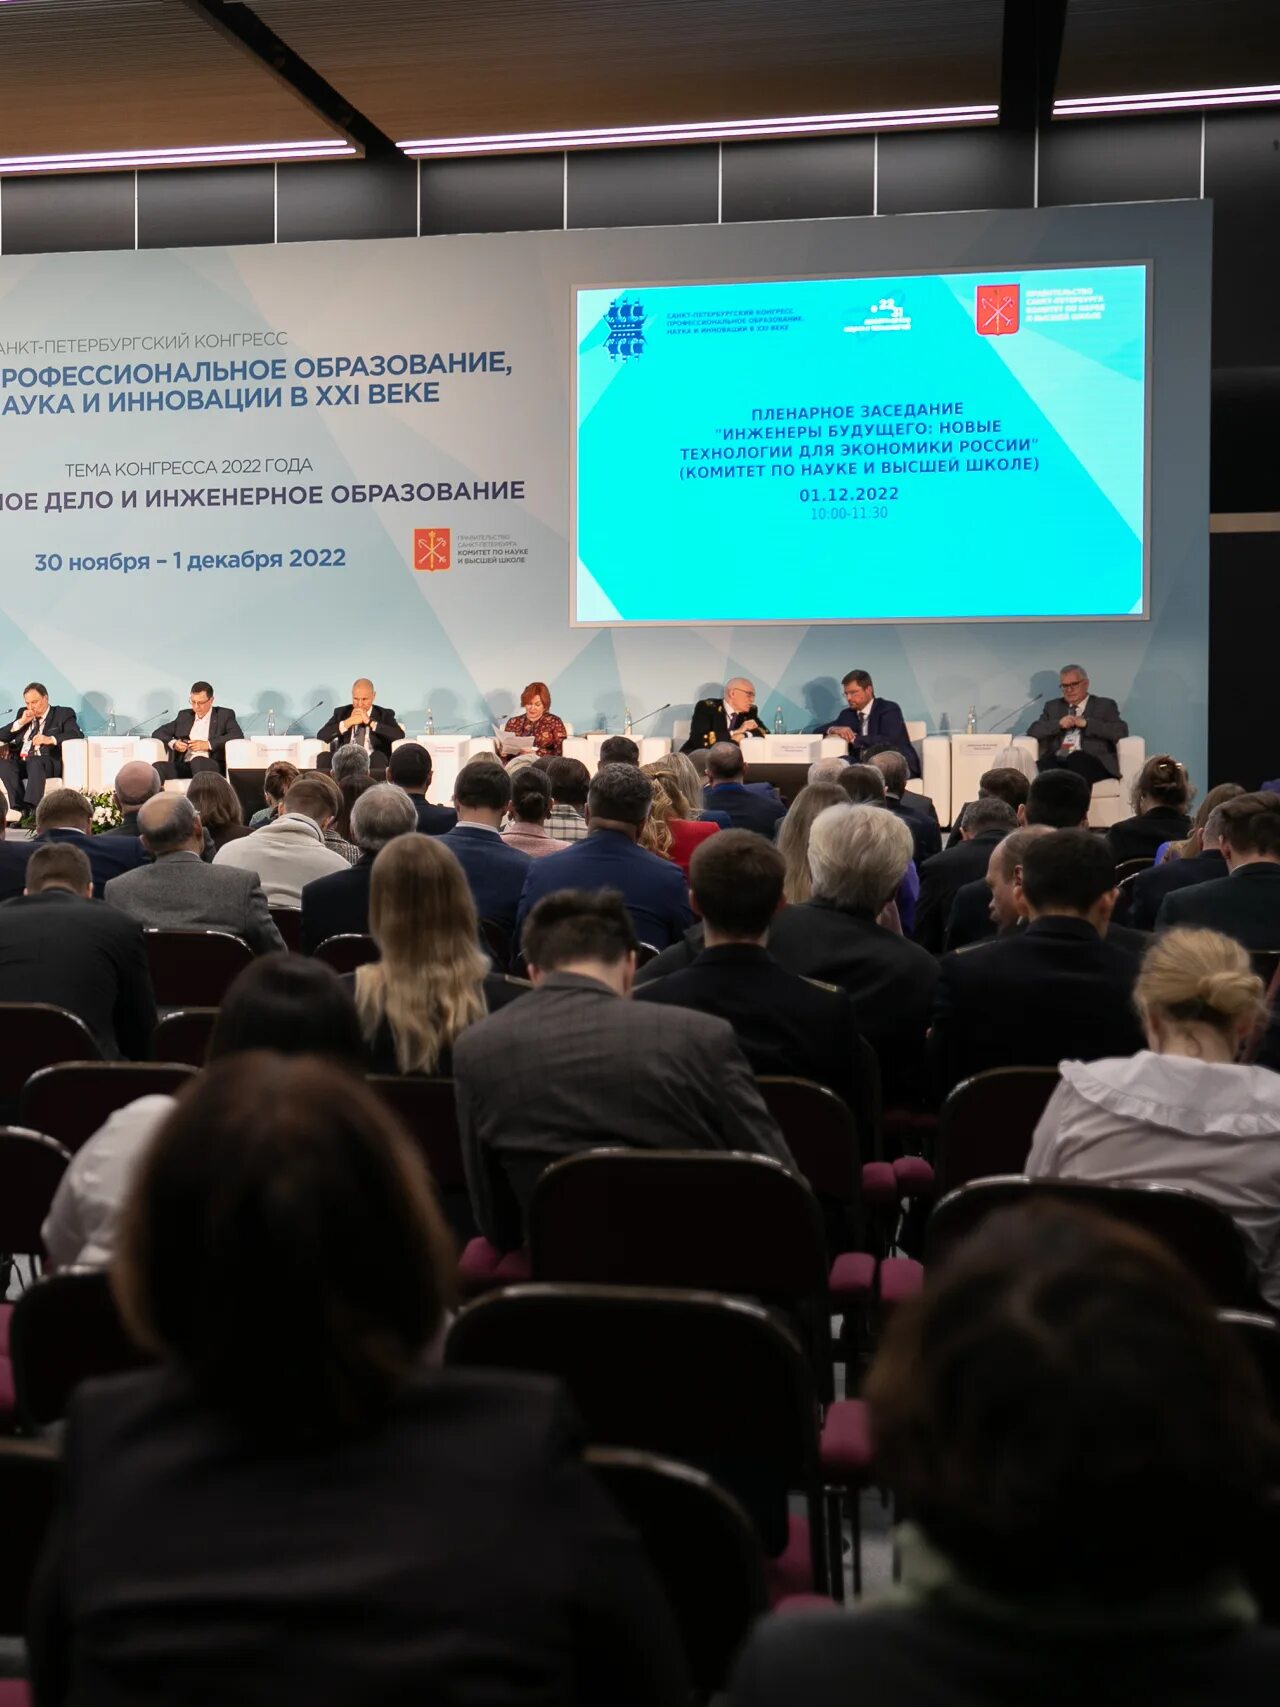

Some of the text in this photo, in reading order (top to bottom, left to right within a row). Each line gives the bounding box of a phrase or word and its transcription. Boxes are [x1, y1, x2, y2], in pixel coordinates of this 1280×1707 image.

[195, 332, 288, 349] КОНГРЕСС
[294, 351, 512, 379] ОБРАЗОВАНИЕ,
[83, 393, 100, 413] И
[109, 387, 282, 412] ИННОВАЦИИ
[290, 386, 308, 407] В
[369, 382, 440, 404] ВЕКЕ
[752, 402, 964, 421] ПЛЕНАРНОЕ ЗАСЕДАНИЕ
[716, 420, 1001, 440] "ИНЖЕНЕРЫ БУДУЩЕГО: НОВЫЕ
[680, 439, 1039, 461] ТЕХНОЛОГИИ ДЛЯ ЭКОНОМИКИ РОССИИ"
[65, 458, 313, 478] ТЕМА КОНГРЕССА 2022 ГОДА
[680, 456, 1039, 481] (КОМИТЕТ ПО НАУКЕ И ВЫСШЕЙ ШКОЛЕ)
[45, 491, 113, 513] ДЕЛО
[121, 490, 137, 508] И
[145, 486, 323, 507] ИНЖЕНЕРНОЕ
[331, 481, 525, 503] ОБРАЗОВАНИЕ
[800, 487, 898, 502] 01.12.2022
[35, 553, 63, 571] 30
[70, 552, 150, 573] ноября
[173, 552, 181, 569] 1
[187, 549, 282, 571] декабря
[289, 548, 346, 567] 2022
[464, 556, 497, 564] ВЫСШЕЙ
